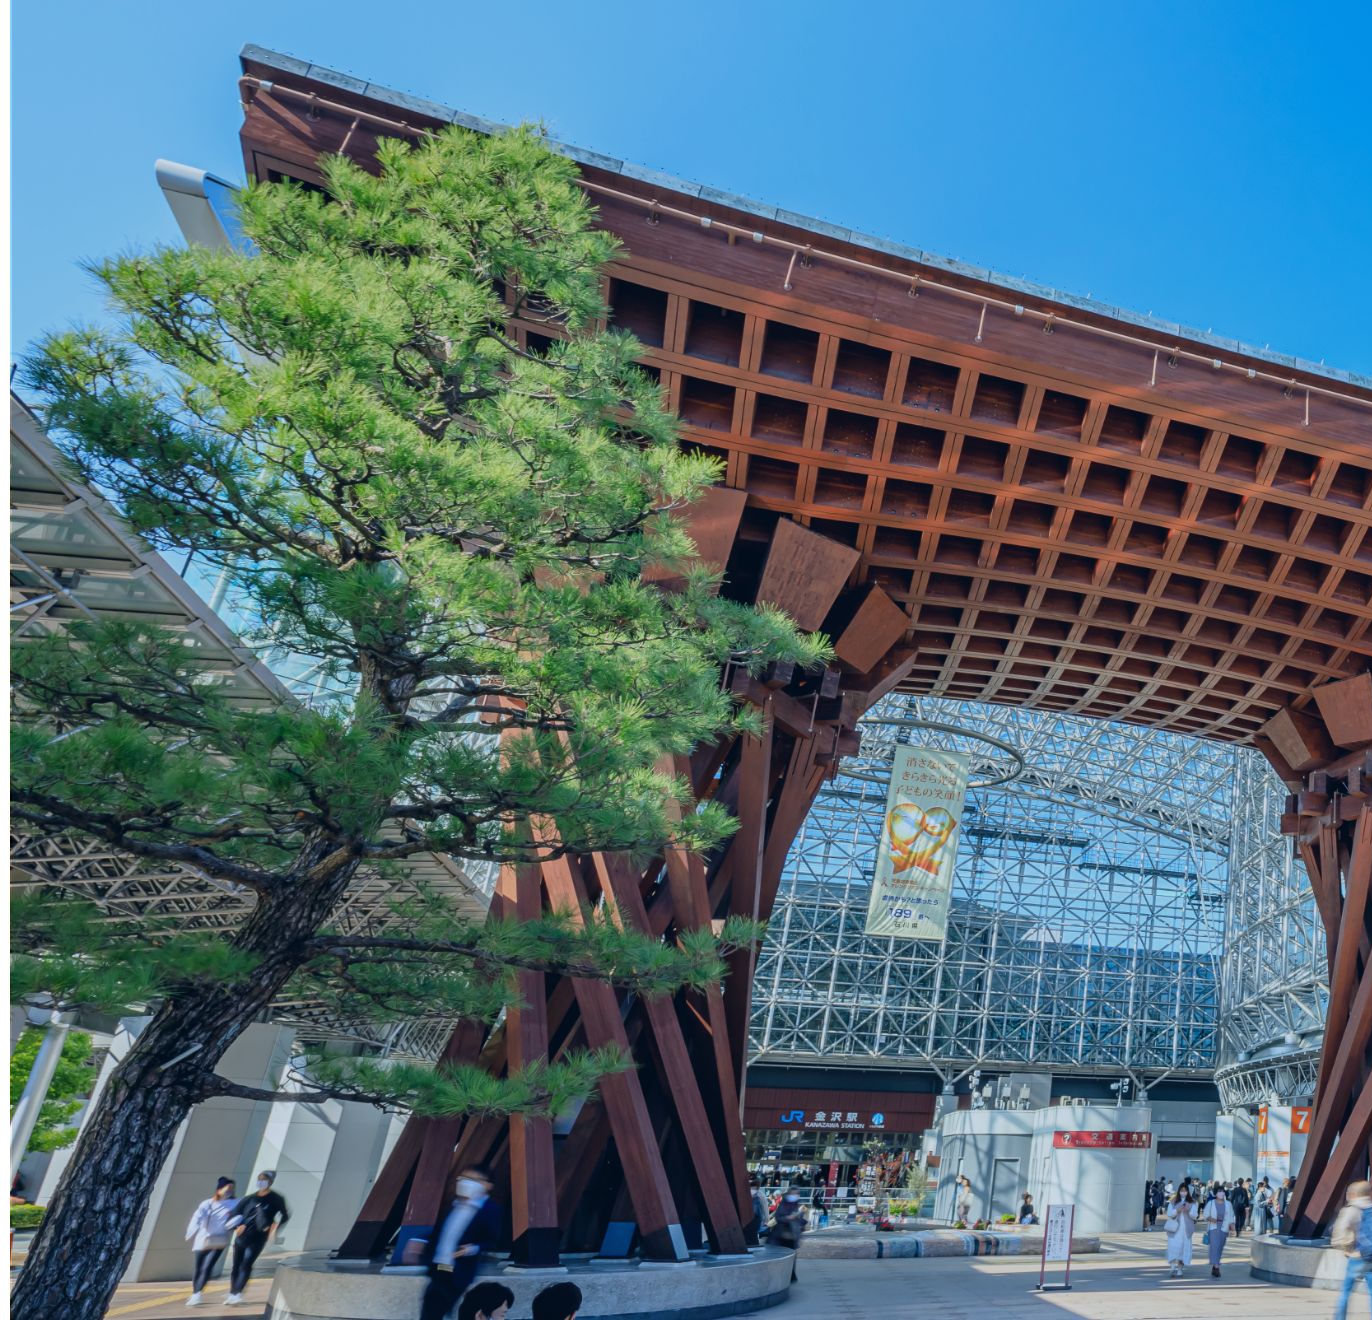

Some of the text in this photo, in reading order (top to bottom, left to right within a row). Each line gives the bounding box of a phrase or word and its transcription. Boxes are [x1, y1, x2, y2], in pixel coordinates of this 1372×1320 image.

[888, 907, 912, 918] 189
[781, 1110, 804, 1122] JR
[815, 1111, 857, 1122] 金沢駅
[1296, 1110, 1309, 1130] 7
